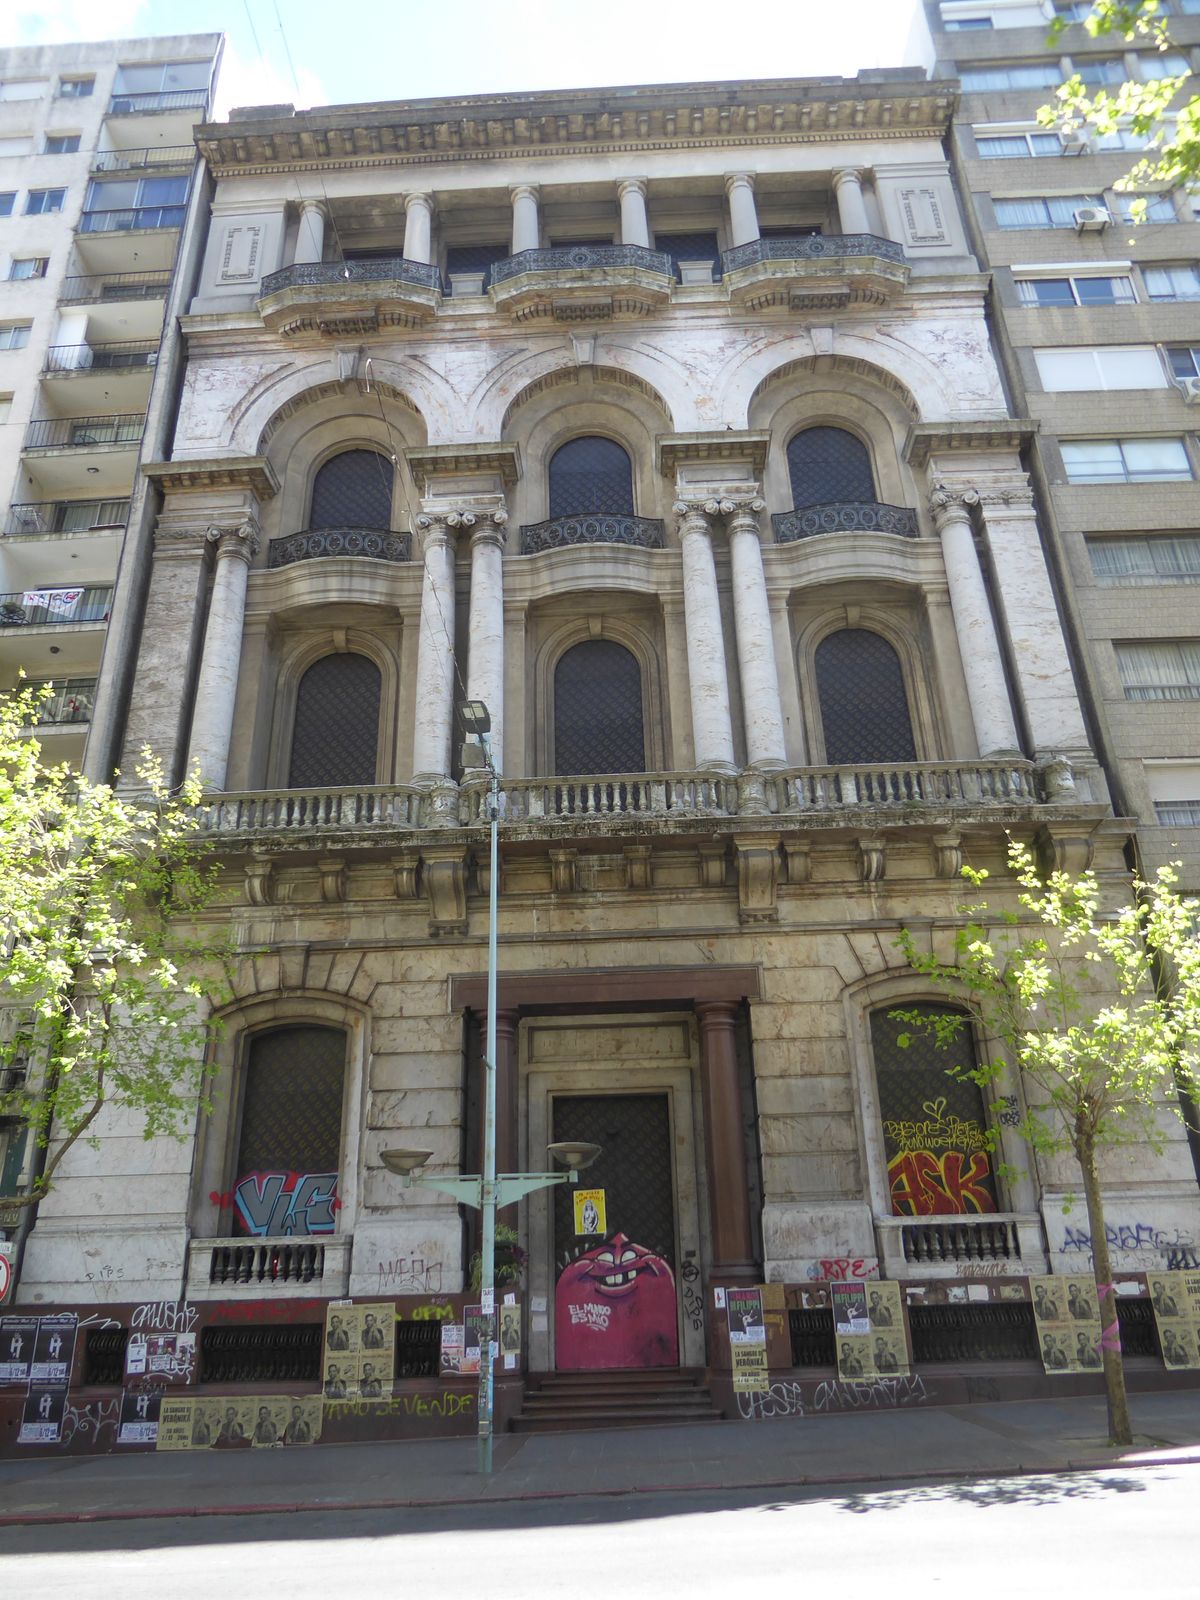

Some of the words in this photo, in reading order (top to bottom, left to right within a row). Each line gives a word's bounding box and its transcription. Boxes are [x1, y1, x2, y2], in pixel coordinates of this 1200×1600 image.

[568, 1304, 583, 1315] EL
[583, 1302, 611, 1315] MUNDO
[404, 1391, 473, 1417] VENDE
